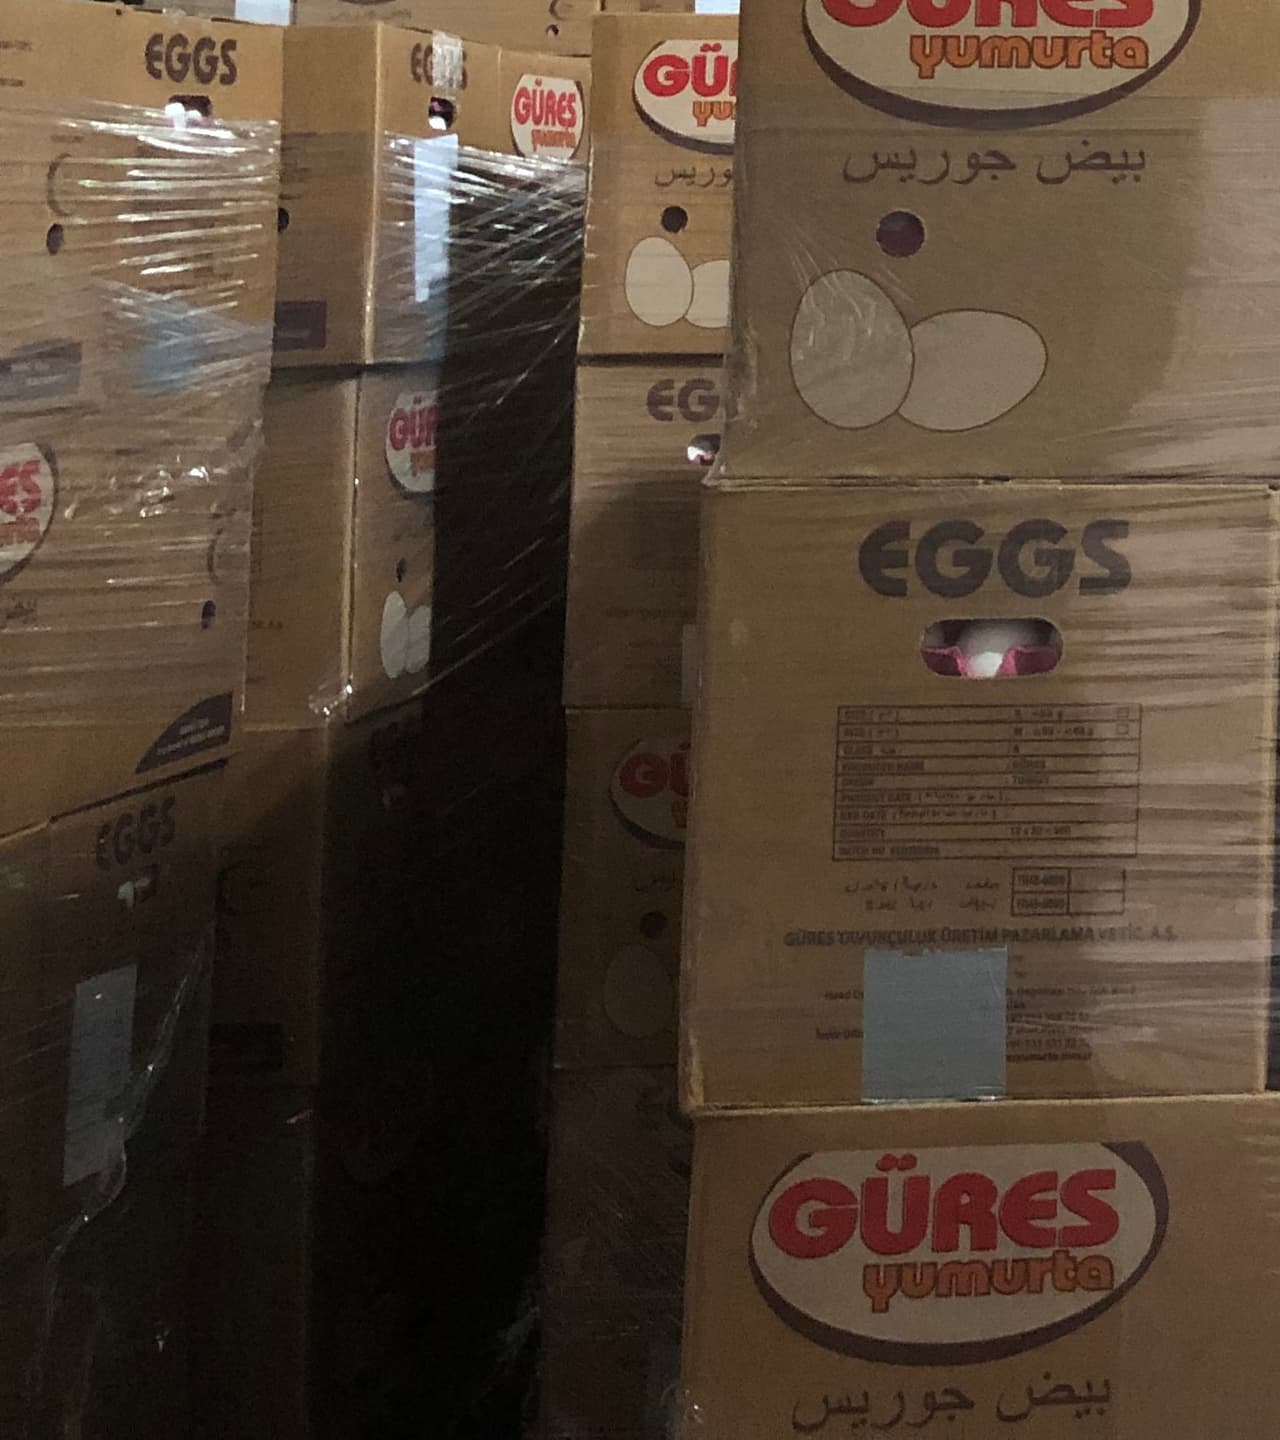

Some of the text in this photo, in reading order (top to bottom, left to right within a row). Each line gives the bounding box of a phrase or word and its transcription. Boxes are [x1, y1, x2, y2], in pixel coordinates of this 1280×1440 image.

[145, 32, 238, 86] EGGS
[909, 30, 1150, 79] yumurta
[514, 79, 576, 128] GÜRES
[842, 141, 1146, 186] بيض جوريس
[858, 518, 1132, 598] EGGS
[769, 1154, 1119, 1258] GÜRES
[862, 1250, 1114, 1313] yumurta
[792, 1372, 1112, 1432] بيض جوريس
